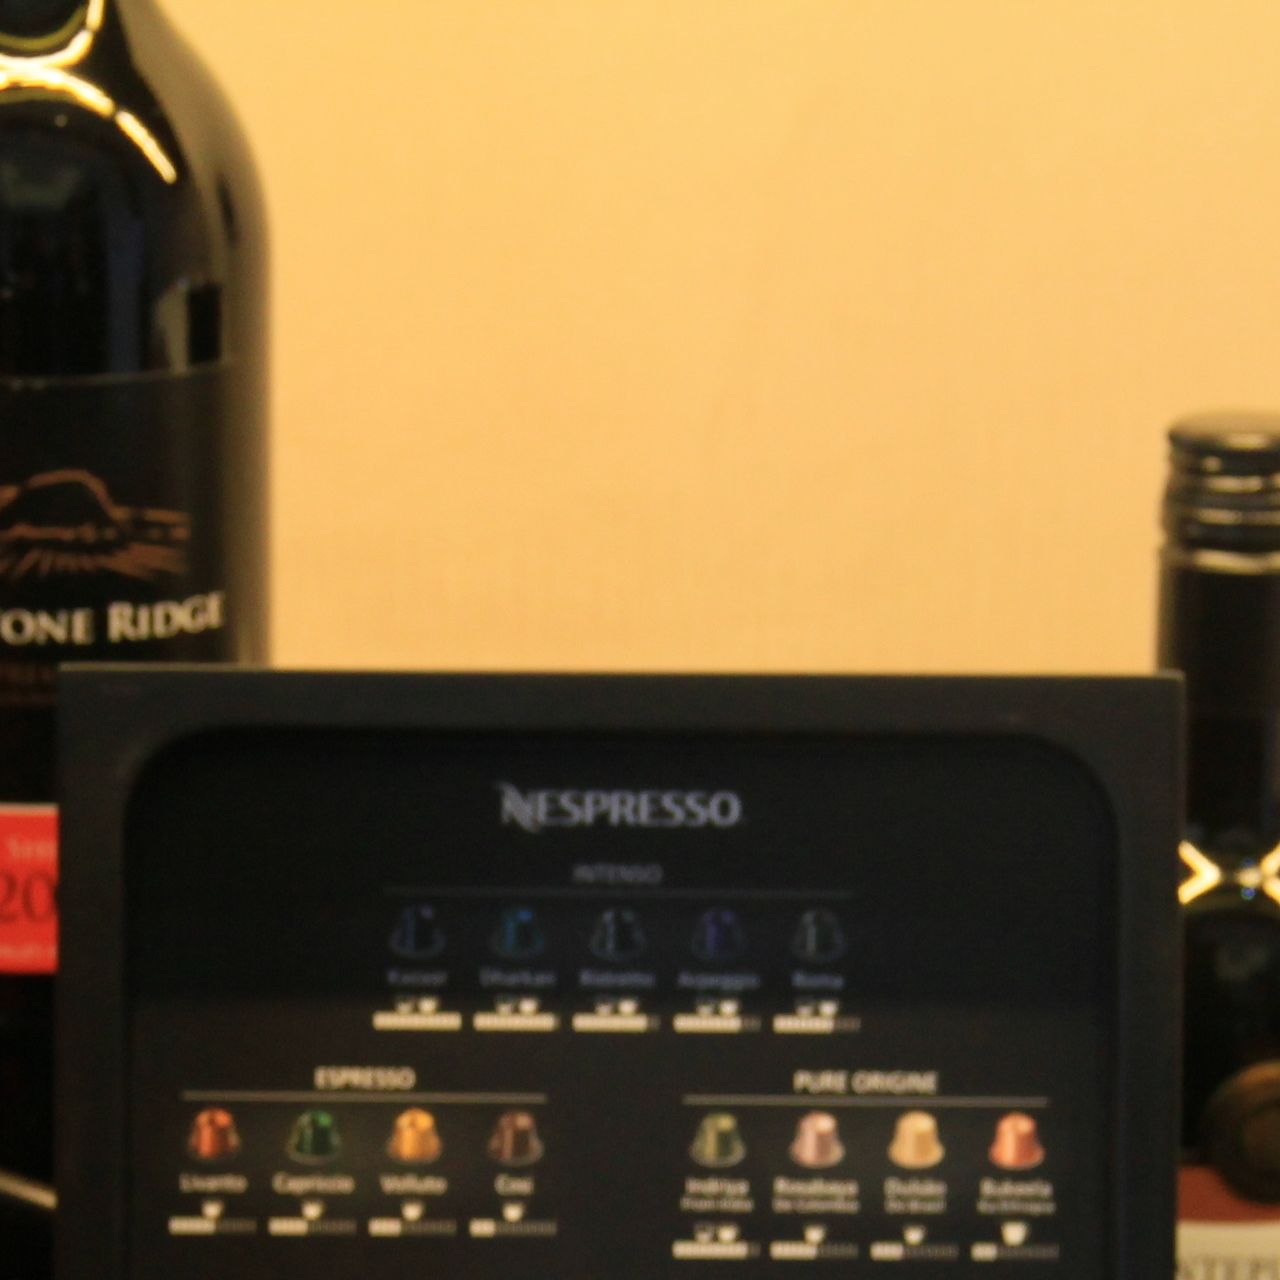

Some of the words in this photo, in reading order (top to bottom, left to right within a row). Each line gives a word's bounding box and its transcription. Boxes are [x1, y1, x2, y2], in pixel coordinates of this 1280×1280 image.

[107, 591, 224, 643] RIDGE
[499, 781, 743, 831] NESPRESSO
[314, 1065, 416, 1089] ESPRESSO
[793, 1070, 848, 1093] PURE
[851, 1071, 938, 1095] ORIGINE
